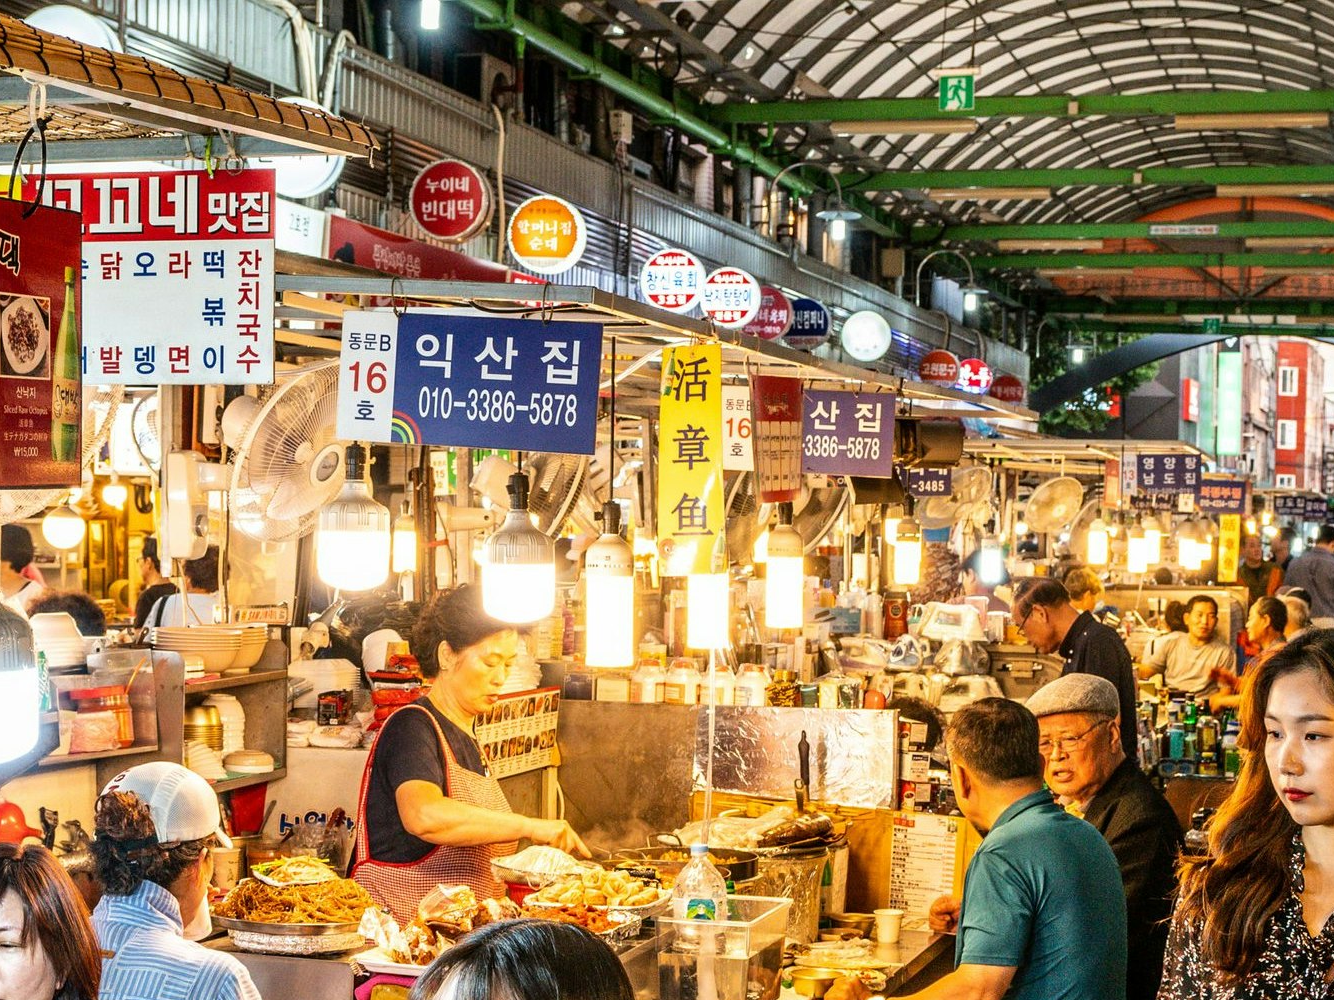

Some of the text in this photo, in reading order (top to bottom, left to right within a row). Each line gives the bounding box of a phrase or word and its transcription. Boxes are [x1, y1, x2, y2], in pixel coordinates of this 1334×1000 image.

[425, 176, 470, 193] 누이네
[208, 191, 271, 234] 맛집
[422, 199, 474, 221] 빈대떡
[517, 219, 572, 236] 할머니집
[529, 237, 559, 252] 순대
[647, 271, 698, 291] 창신육회
[202, 250, 226, 374] 떡볶이
[236, 249, 262, 374] 잔치국수
[348, 332, 391, 352] 동문B
[348, 361, 387, 394] 16
[16, 387, 36, 399] 산낙지
[4, 405, 17, 414] Sliced
[19, 405, 28, 414] Raw
[354, 400, 376, 422] 호
[418, 386, 577, 427] 010-3386-5878
[726, 417, 751, 439] 16
[14, 447, 39, 458] ₩15,000
[730, 442, 744, 457] 호
